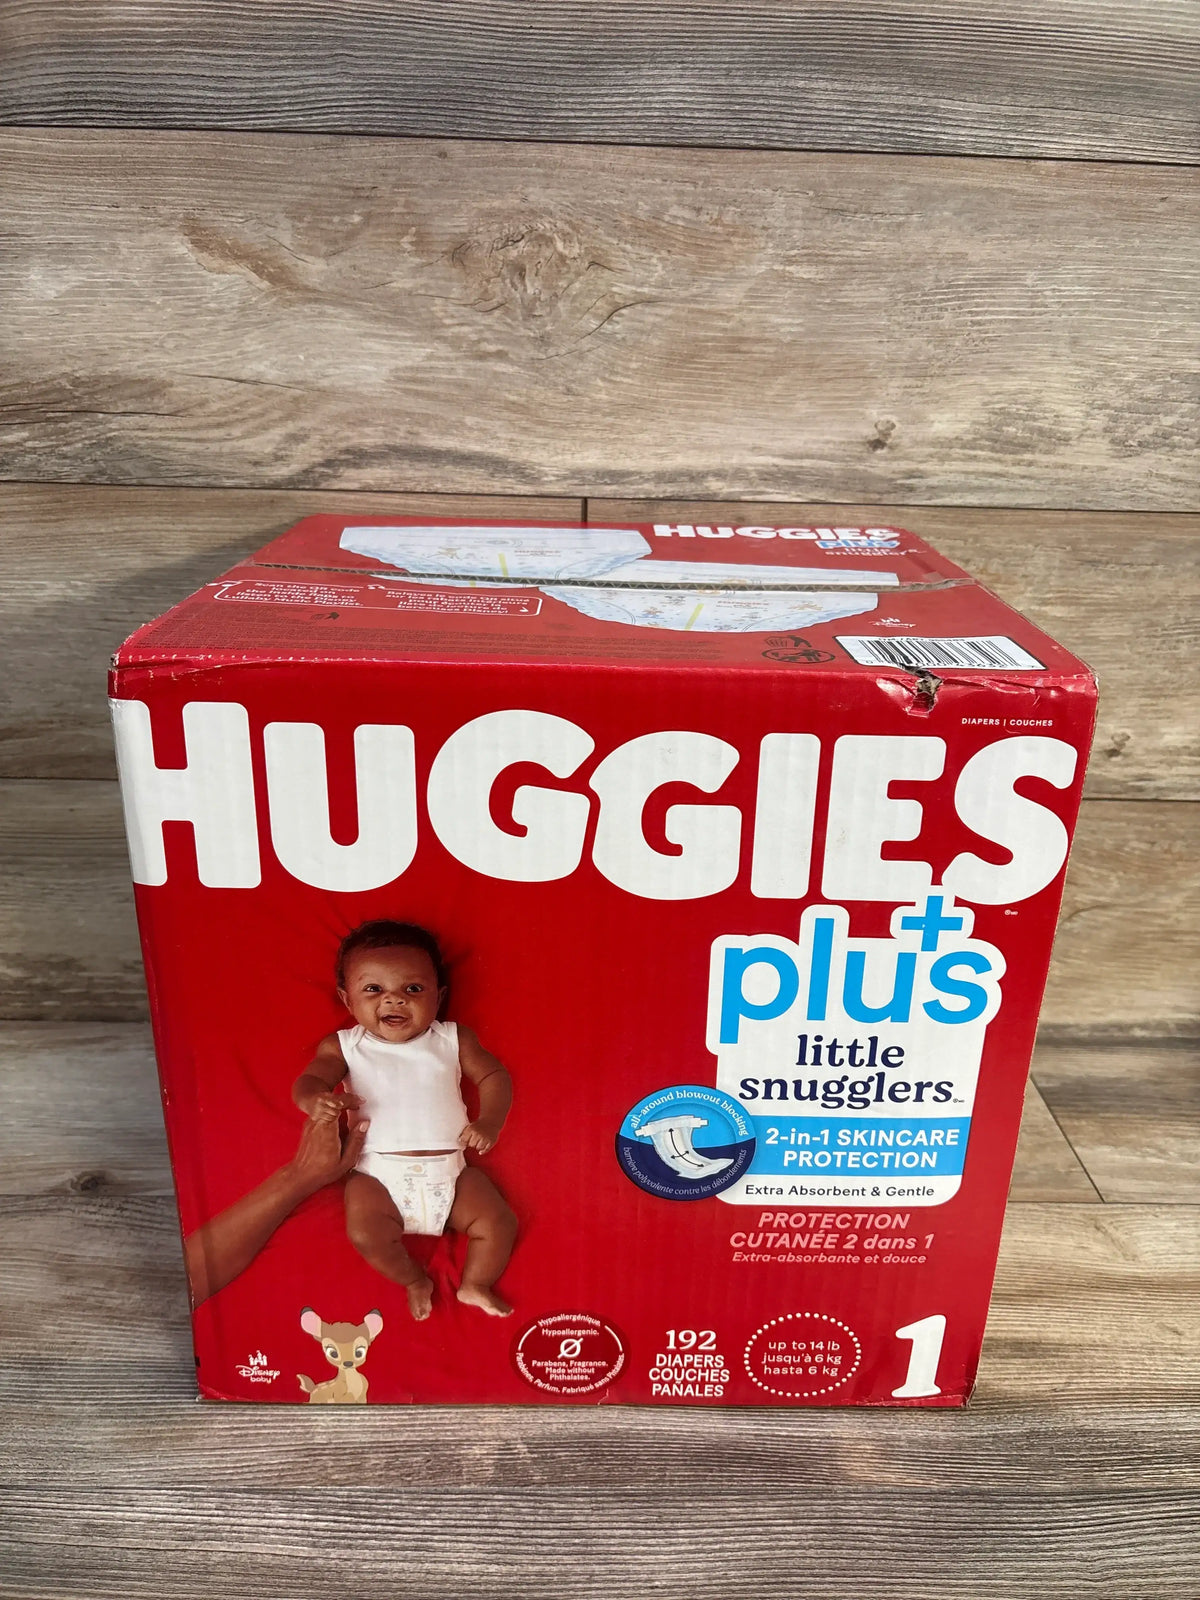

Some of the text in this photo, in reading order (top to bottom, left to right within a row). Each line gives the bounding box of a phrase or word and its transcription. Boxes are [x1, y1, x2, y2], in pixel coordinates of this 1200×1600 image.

[652, 524, 900, 541] HUGGIES
[961, 718, 1054, 727] DIAPERS COUCHES
[109, 698, 1078, 905] HUGGIES
[719, 917, 993, 1044] plus
[795, 1034, 905, 1068] little
[738, 1072, 955, 1110] snugglers
[630, 1090, 749, 1136] all-around blowout blocking
[765, 1128, 960, 1147] 2-in-1 SKINCARE
[783, 1151, 938, 1168] PROTECTION
[633, 1169, 674, 1194] polyvalente
[674, 1187, 700, 1195] contre
[700, 1185, 712, 1193] les
[745, 1184, 935, 1197] Extra Absorbent & Gentle
[758, 1212, 910, 1230] PROTECTION
[729, 1229, 935, 1250] CUTANÉE 2 dans 1
[732, 1251, 926, 1264] Extra-absorbante et douce
[665, 1329, 717, 1350] 192
[768, 1340, 841, 1351] up to 14 lb
[655, 1354, 725, 1368] DIAPERS
[814, 1354, 824, 1363] 6
[826, 1353, 842, 1366] kg
[891, 1314, 947, 1398] 1
[235, 1365, 281, 1380] Disney
[648, 1368, 730, 1383] COUCHES
[763, 1365, 839, 1377] hasta 6 kg
[652, 1380, 724, 1397] PAÑALES
